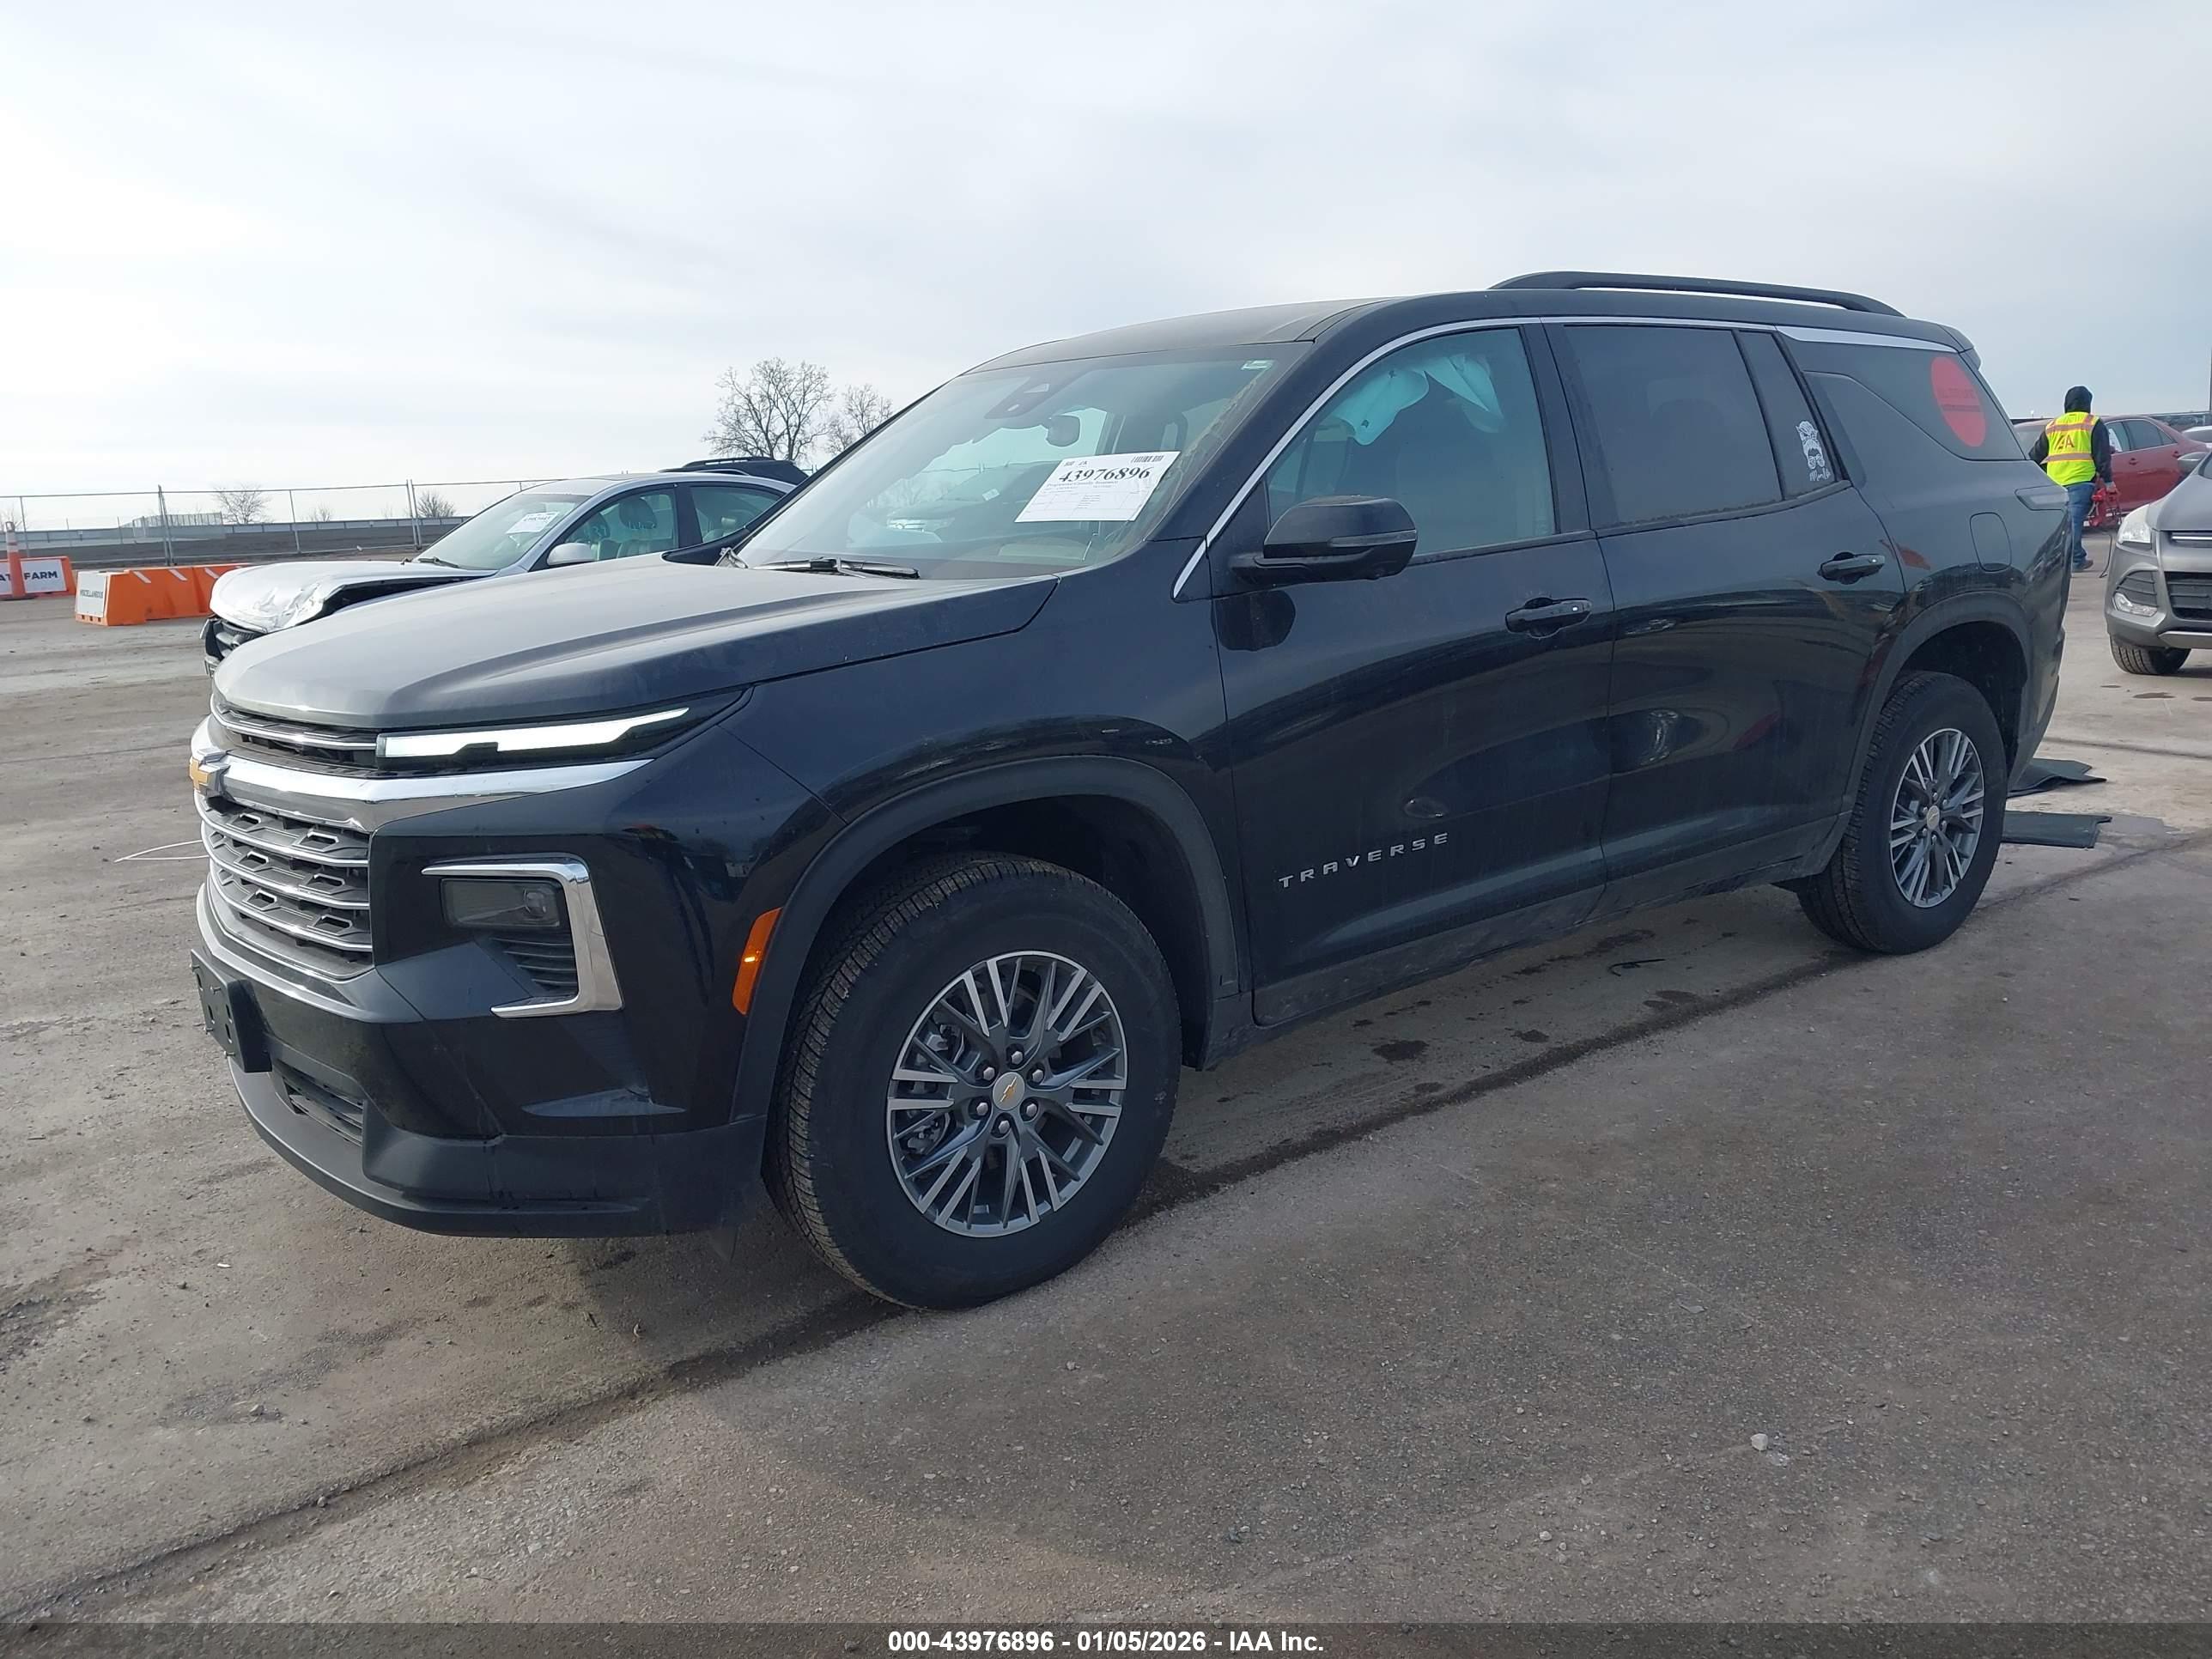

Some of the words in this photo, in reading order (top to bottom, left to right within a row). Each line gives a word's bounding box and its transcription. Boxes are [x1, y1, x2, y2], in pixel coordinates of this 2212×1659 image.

[1059, 466, 1154, 483] 43976896
[23, 570, 58, 580] FARM
[1279, 832, 1449, 889] TRAVERSE
